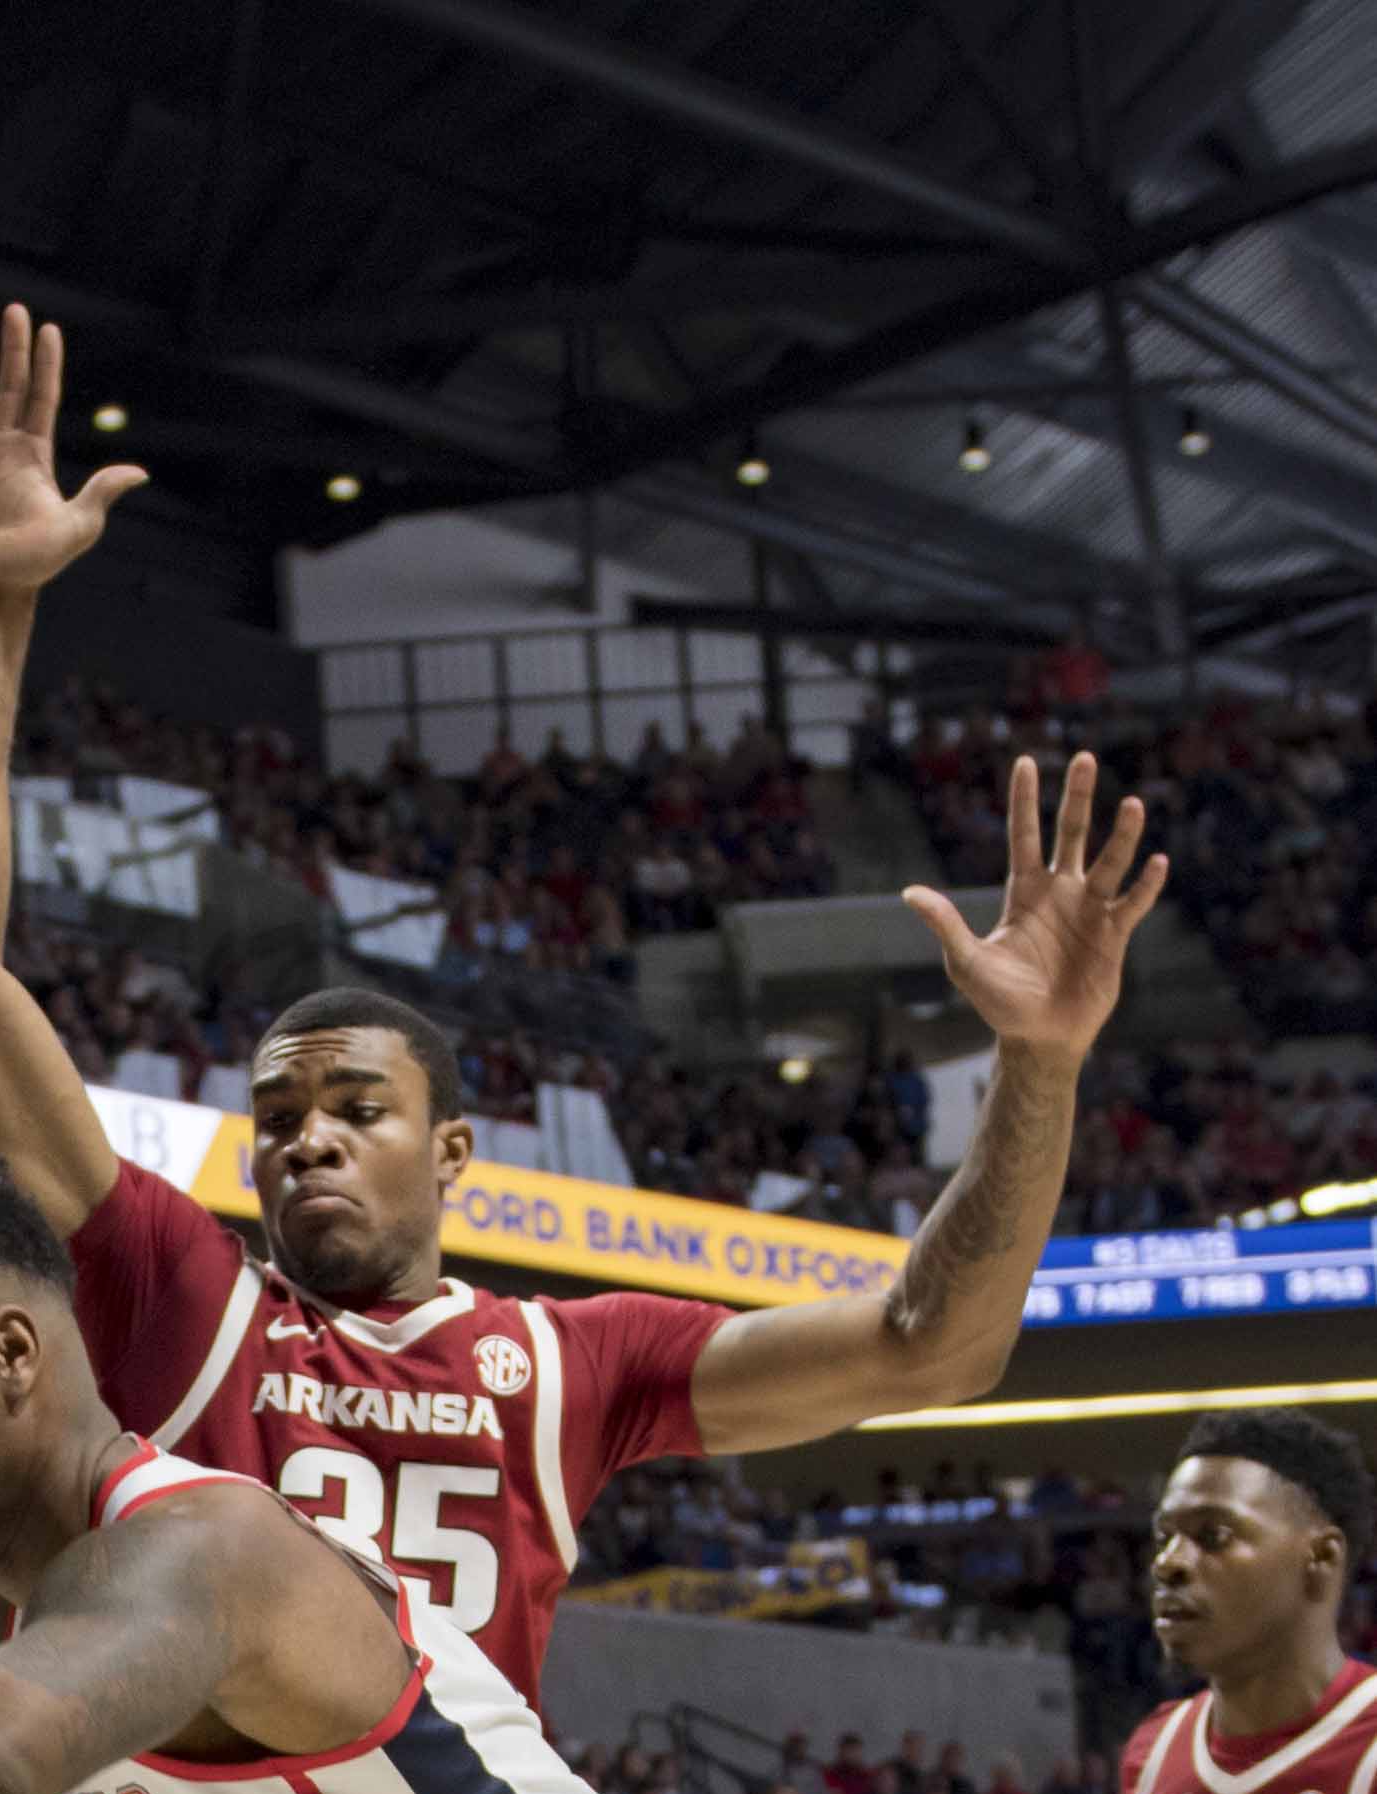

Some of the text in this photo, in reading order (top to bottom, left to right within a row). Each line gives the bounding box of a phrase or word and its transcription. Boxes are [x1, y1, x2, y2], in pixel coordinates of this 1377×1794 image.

[586, 1207, 713, 1271] BANK
[477, 1341, 529, 1393] SEC
[279, 1446, 501, 1634] 35
